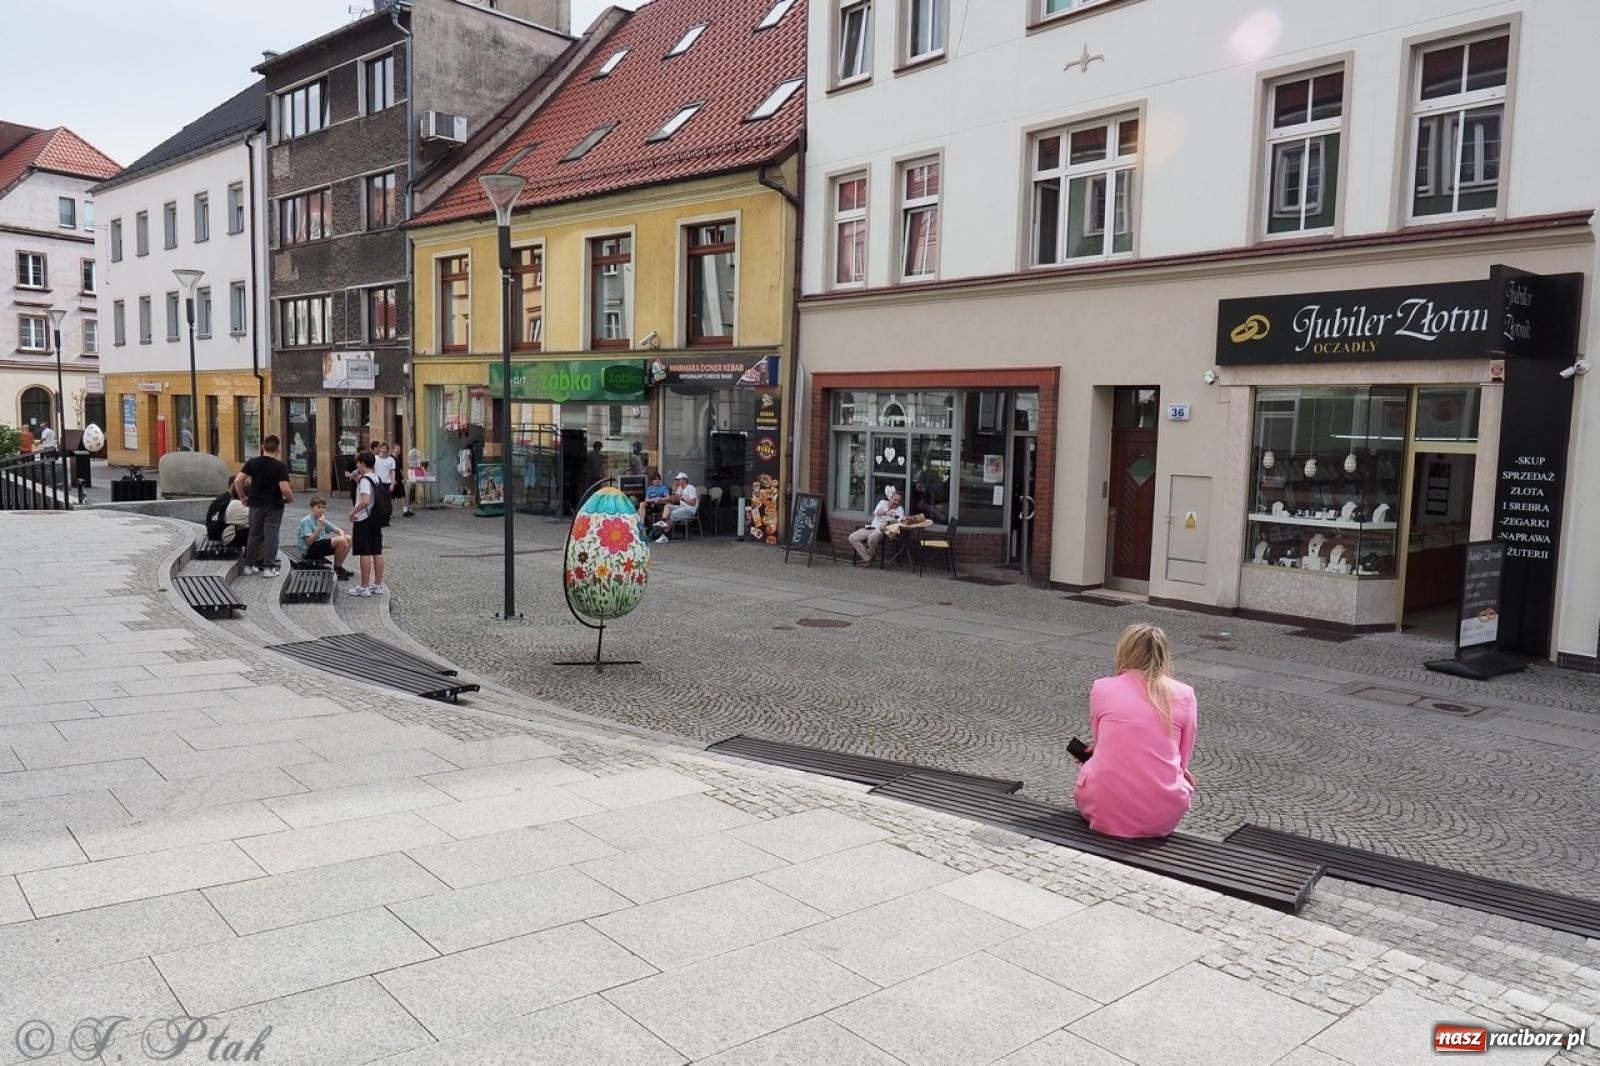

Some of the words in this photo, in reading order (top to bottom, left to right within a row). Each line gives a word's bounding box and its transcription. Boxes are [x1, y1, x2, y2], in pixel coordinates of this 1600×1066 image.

[1293, 304, 1393, 352] Jubiler
[1395, 298, 1488, 341] Złotni
[723, 363, 744, 372] KEBAB
[1171, 407, 1184, 417] 36
[1502, 470, 1555, 481] SPRZEDAŻ
[1509, 501, 1550, 512] SREBRA
[1506, 546, 1549, 559] ŻUTERII
